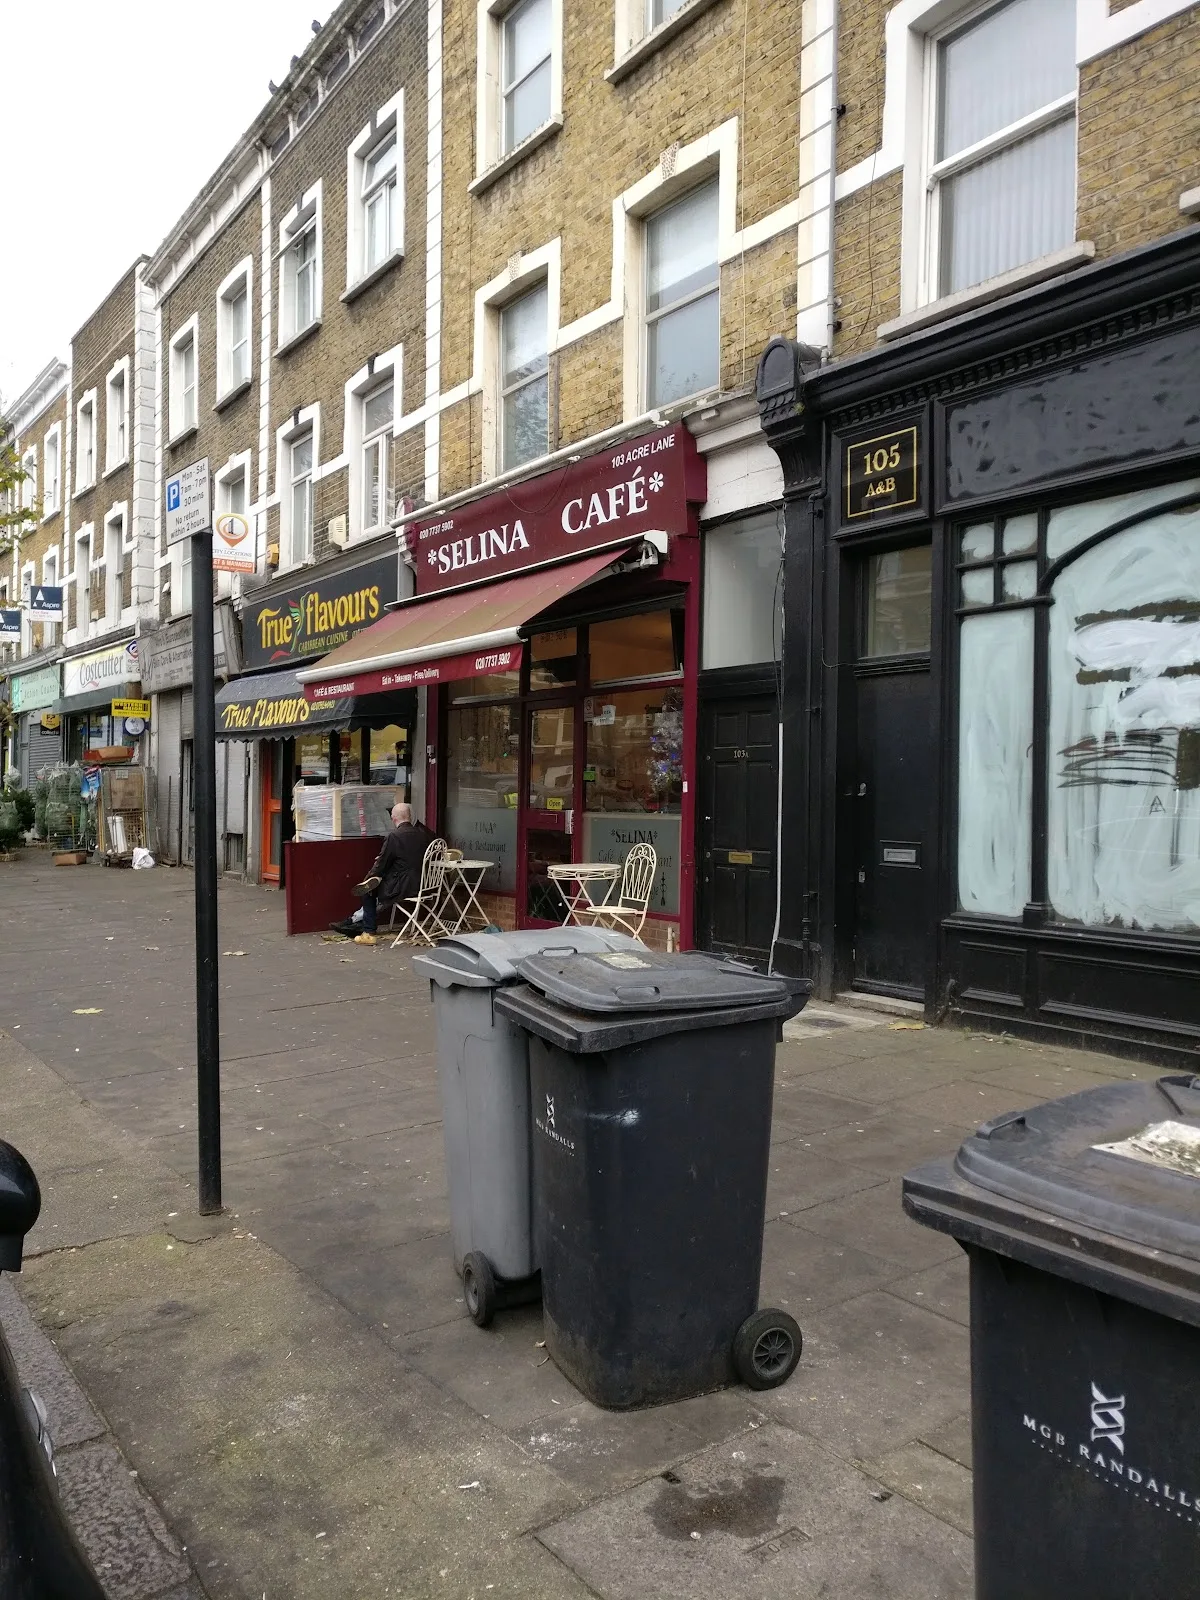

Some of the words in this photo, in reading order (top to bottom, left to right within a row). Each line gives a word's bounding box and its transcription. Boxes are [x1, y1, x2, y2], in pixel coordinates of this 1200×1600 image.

[611, 454, 625, 469] 103
[625, 444, 650, 465] ACRE
[651, 433, 676, 455] LANE
[863, 442, 900, 475] 105
[196, 464, 205, 475] Sat
[169, 484, 179, 509] P
[864, 476, 896, 498] A&B
[183, 496, 192, 507] 30
[175, 515, 183, 525] No
[183, 508, 200, 522] return
[257, 607, 293, 649] True
[306, 585, 379, 636] flavours
[298, 636, 326, 653] CARIBBEAN
[326, 630, 349, 646] CUISINE
[80, 654, 124, 686] Costcutter
[220, 704, 251, 729] True
[1023, 1414, 1066, 1446] MGB
